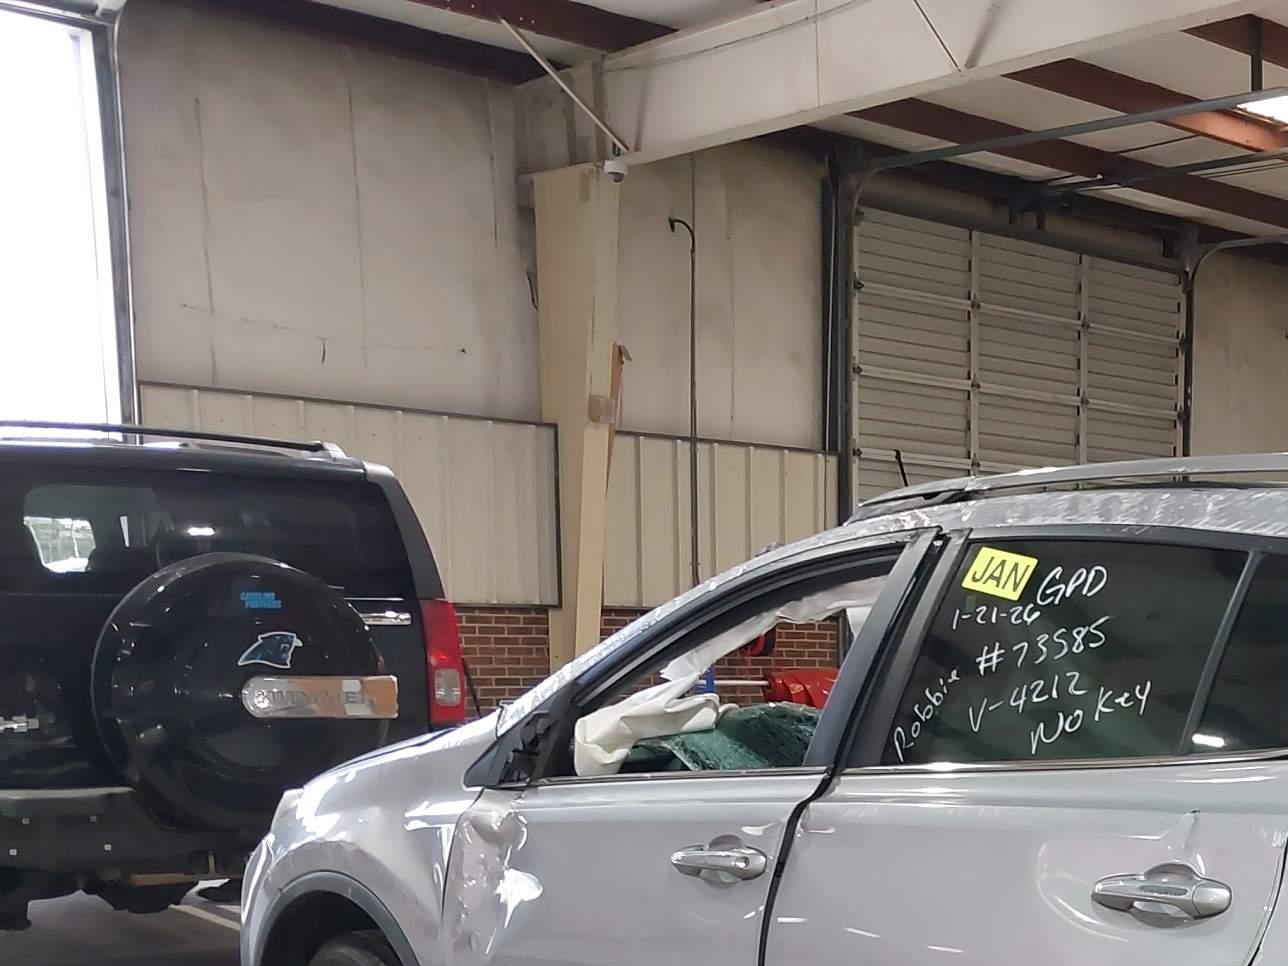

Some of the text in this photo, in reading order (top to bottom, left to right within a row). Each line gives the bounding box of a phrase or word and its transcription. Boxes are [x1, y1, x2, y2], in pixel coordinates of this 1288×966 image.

[971, 556, 1031, 593] JAN
[1036, 565, 1108, 606] GPD
[952, 603, 1041, 630] 1-21-26
[893, 668, 961, 763] Robbie
